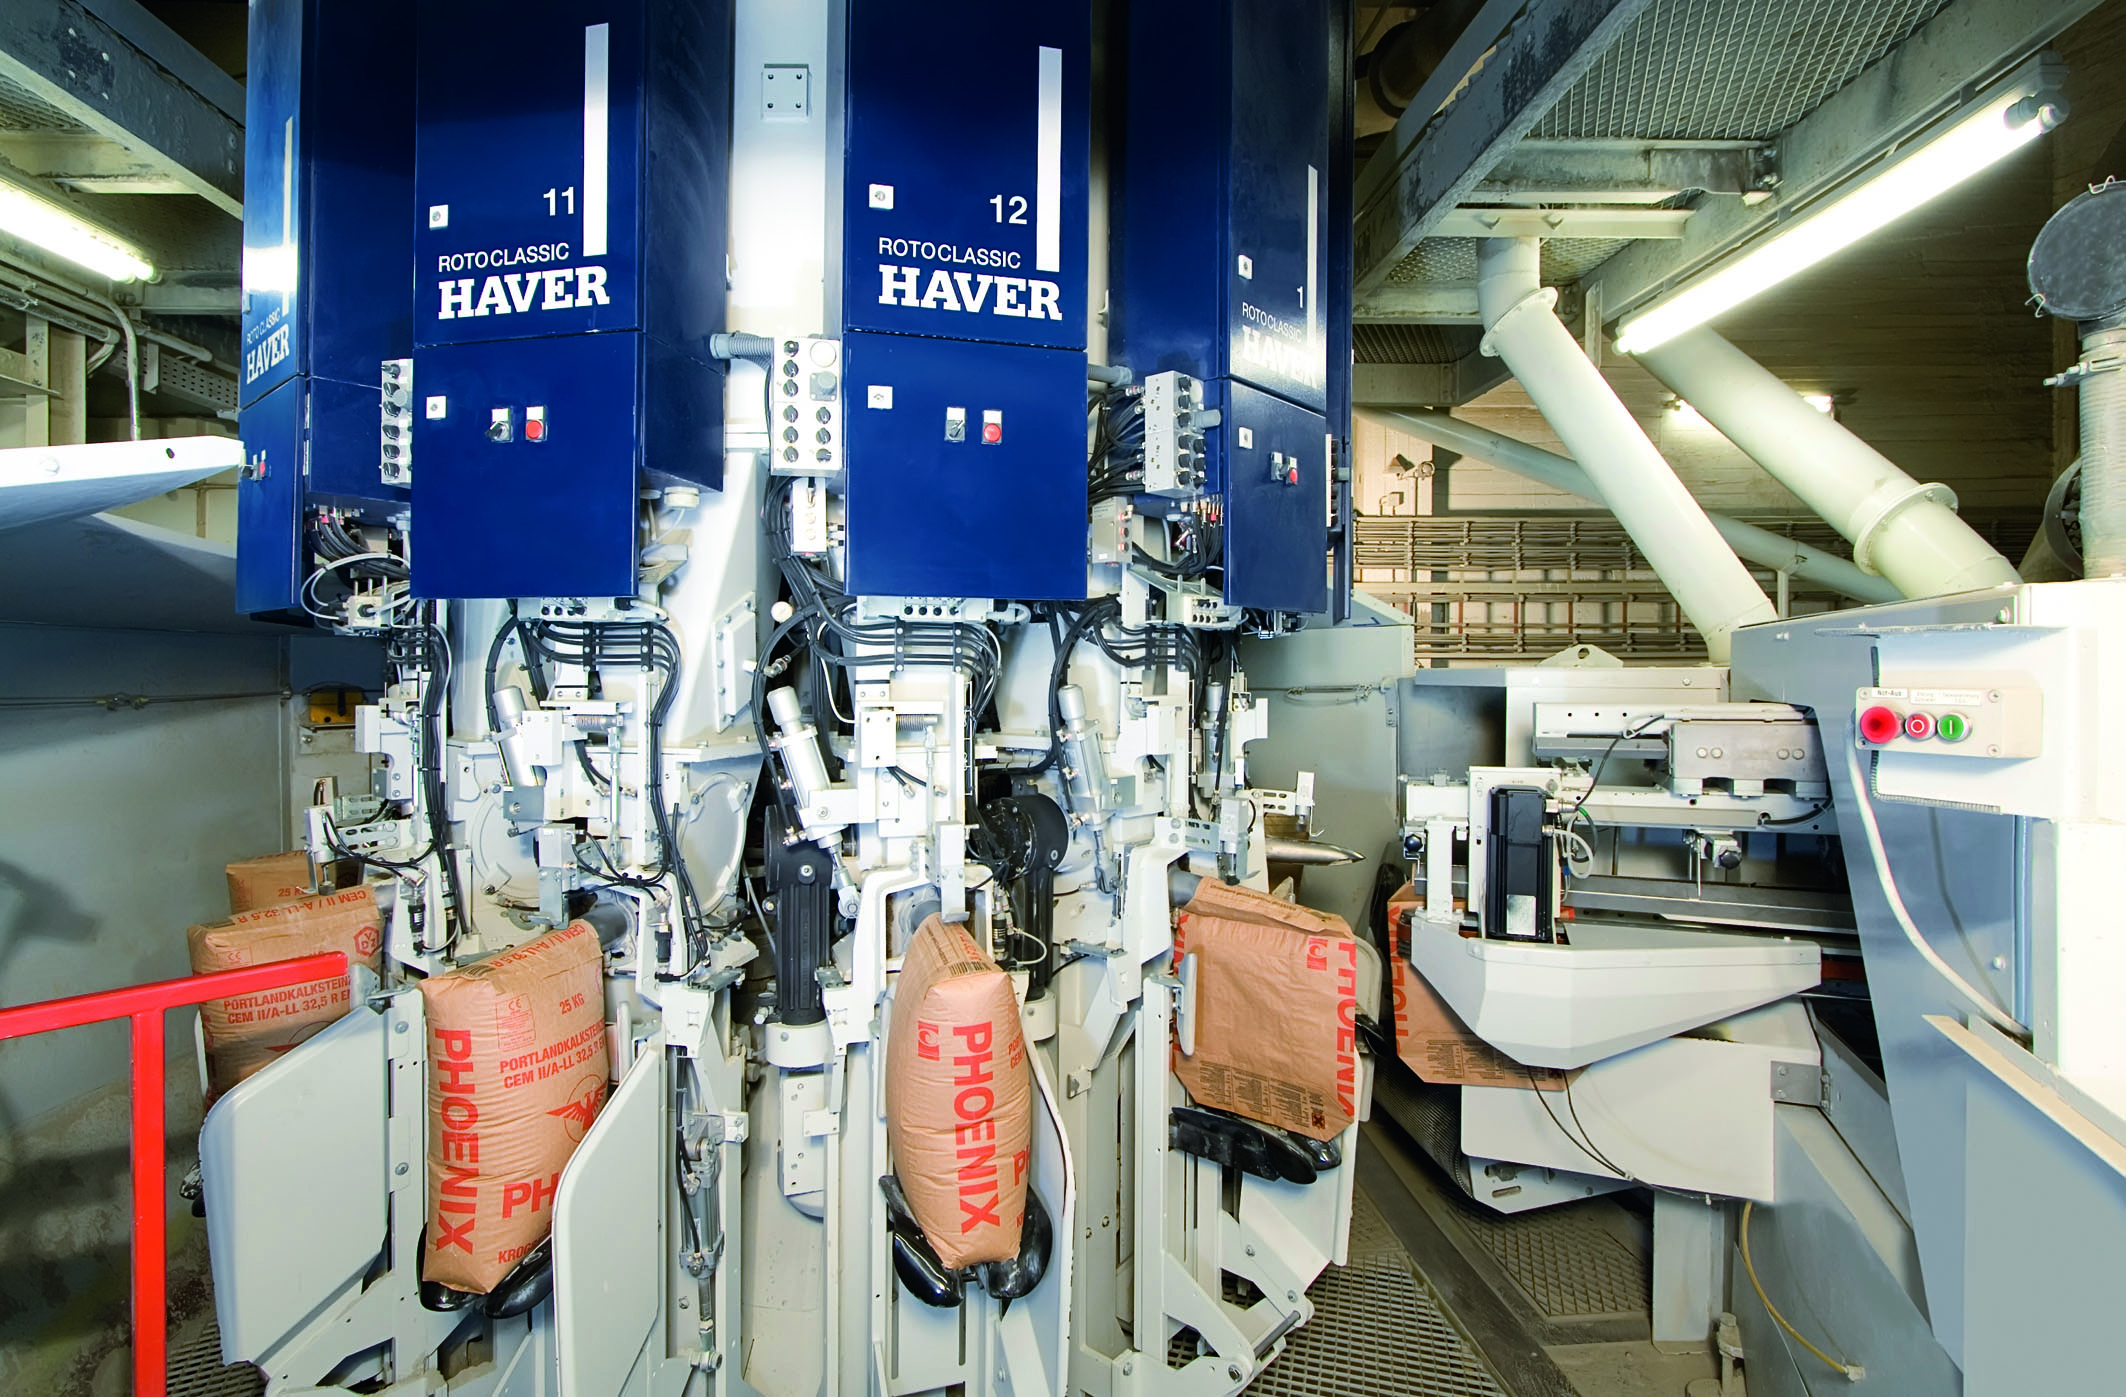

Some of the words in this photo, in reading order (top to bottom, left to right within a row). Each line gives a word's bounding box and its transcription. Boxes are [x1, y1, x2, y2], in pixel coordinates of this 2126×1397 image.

[542, 186, 575, 217] 11
[989, 194, 1028, 225] 12
[438, 265, 611, 320] HAVER
[878, 263, 1063, 321] HAVER
[1296, 285, 1304, 309] 1
[246, 323, 290, 385] HAVER
[338, 889, 367, 904] CEM
[228, 1011, 254, 1025] CEM
[303, 996, 328, 1011] 32,5
[331, 992, 338, 1004] R
[560, 1000, 572, 1015] 25
[572, 993, 585, 1009] KG
[504, 1070, 535, 1089] CEM
[435, 1028, 479, 1256] PHOENIX
[952, 1021, 1001, 1235] PHOENIX
